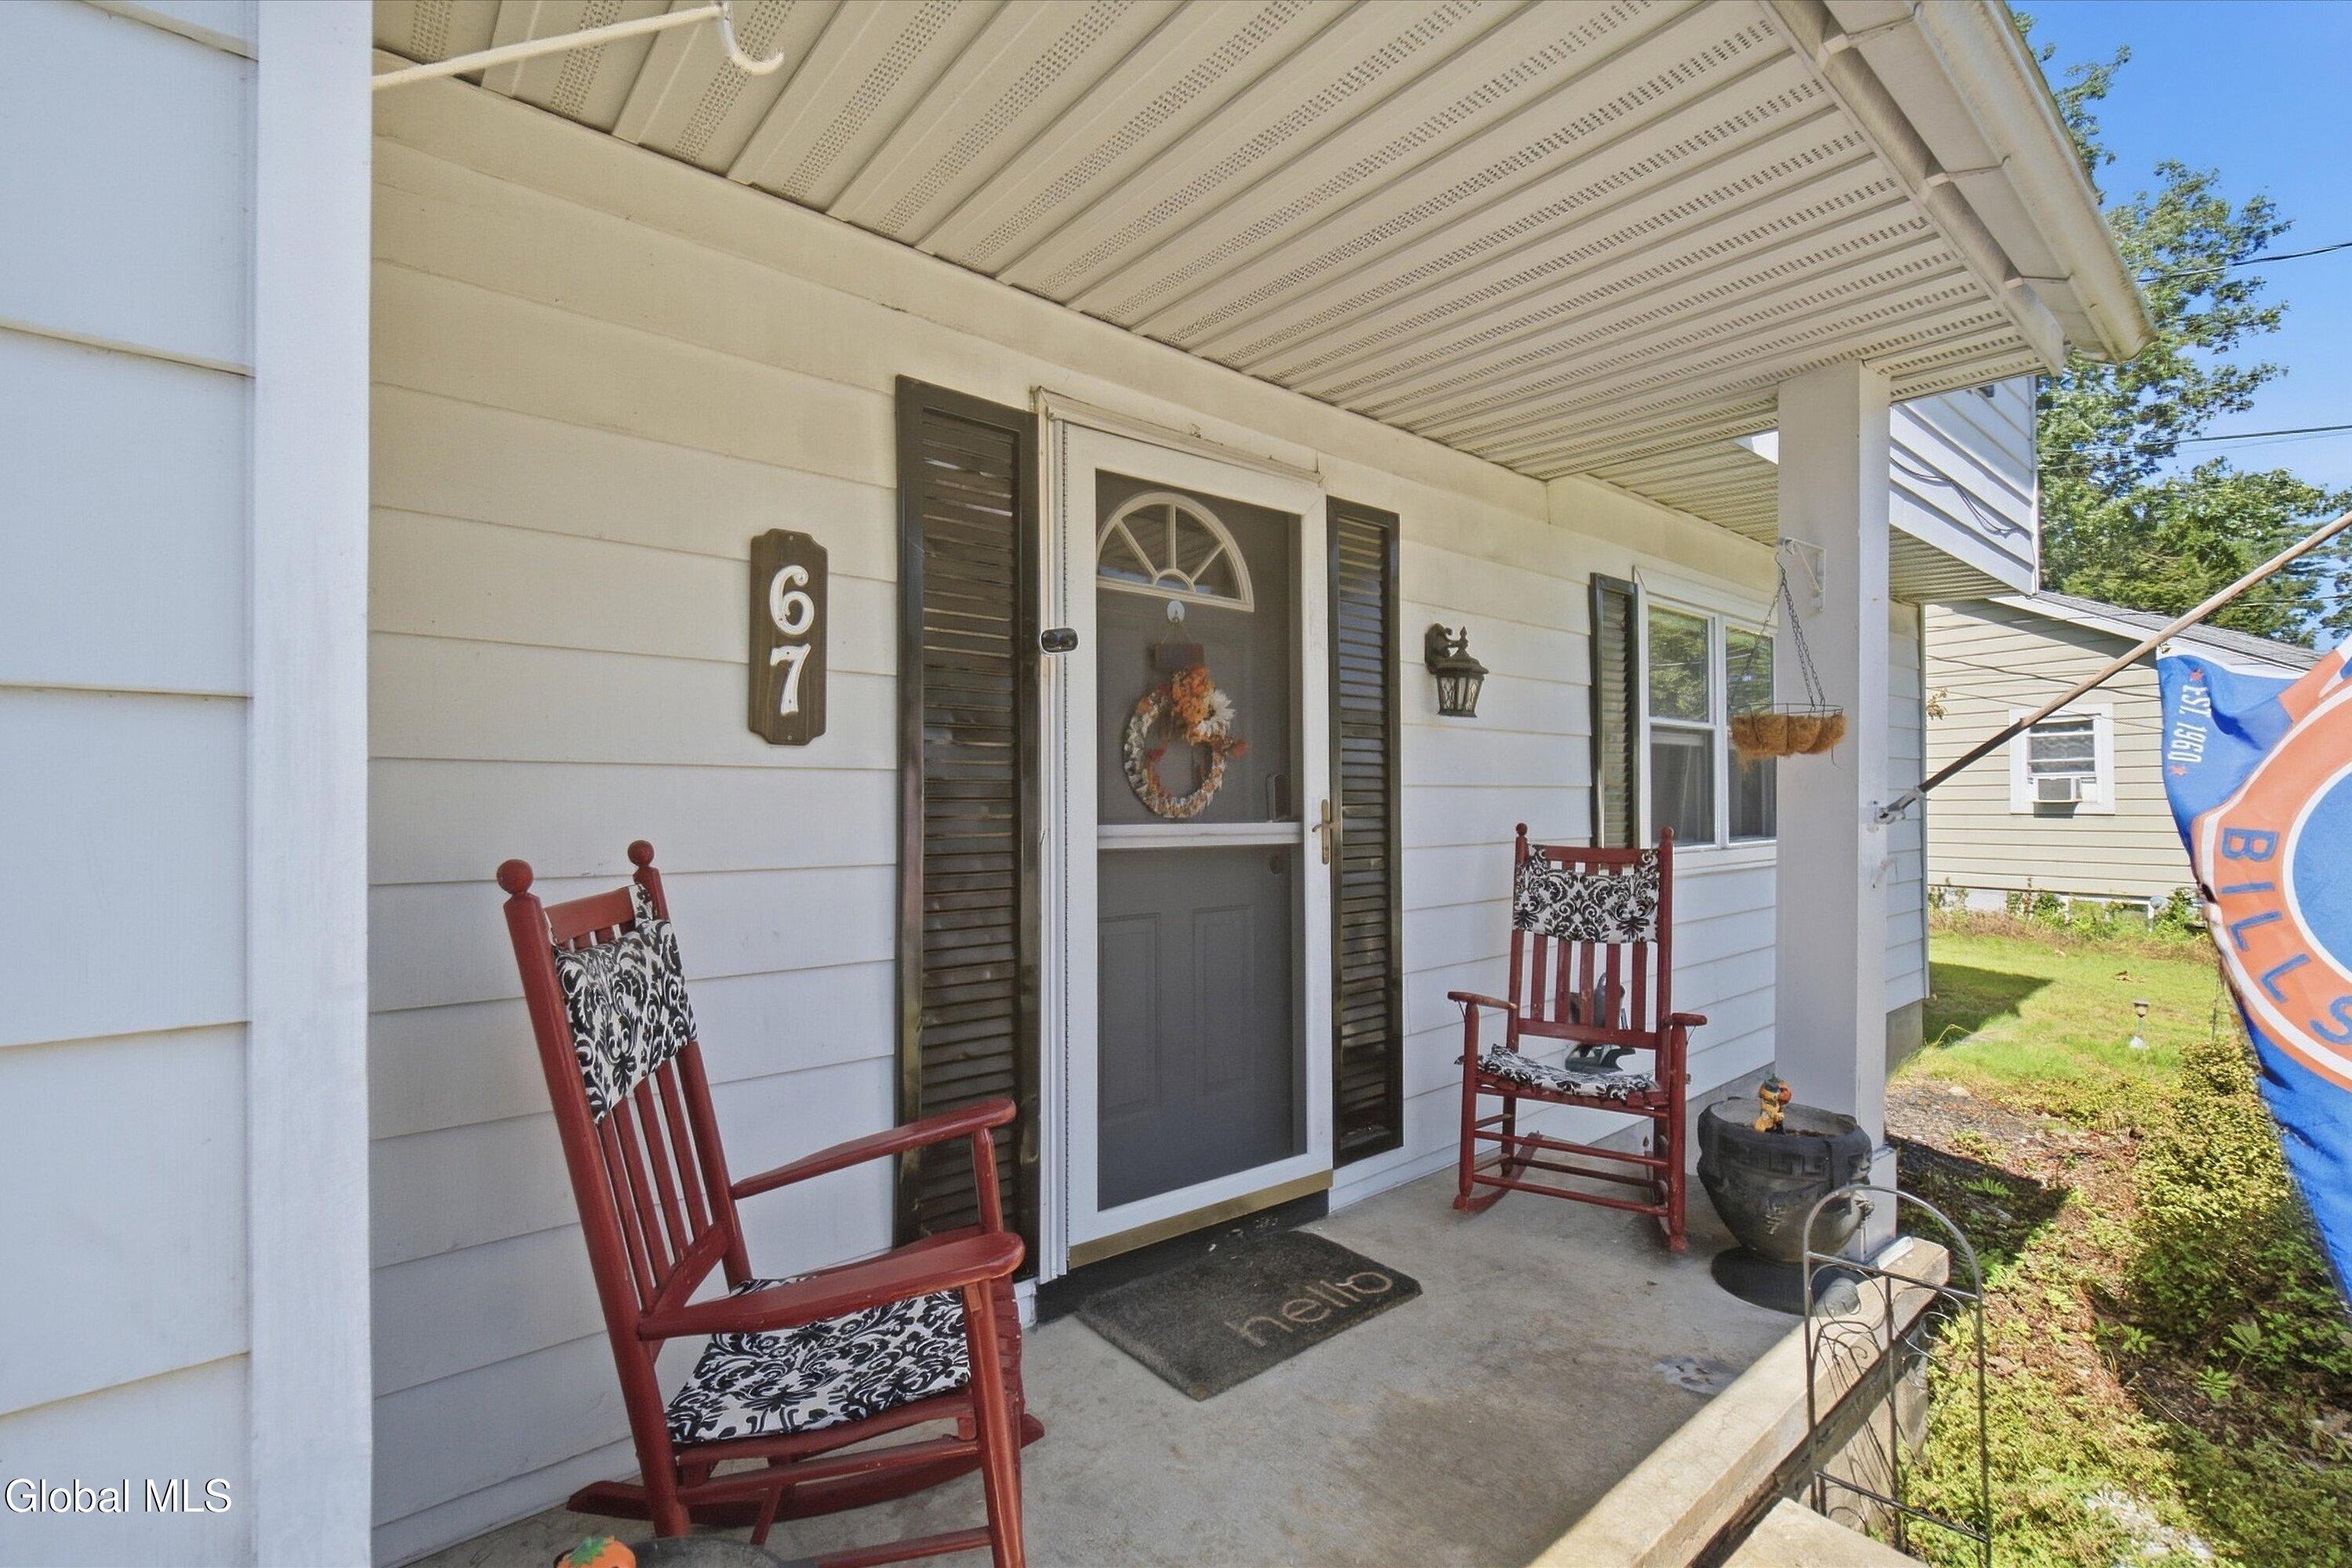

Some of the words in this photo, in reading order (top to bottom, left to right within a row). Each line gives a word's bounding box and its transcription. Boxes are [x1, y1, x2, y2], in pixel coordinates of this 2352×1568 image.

[769, 564, 815, 715] 67
[2179, 684, 2212, 718] EST.
[2167, 721, 2208, 763] 1960
[2221, 827, 2352, 1045] BILLS
[1224, 1272, 1394, 1347] hello
